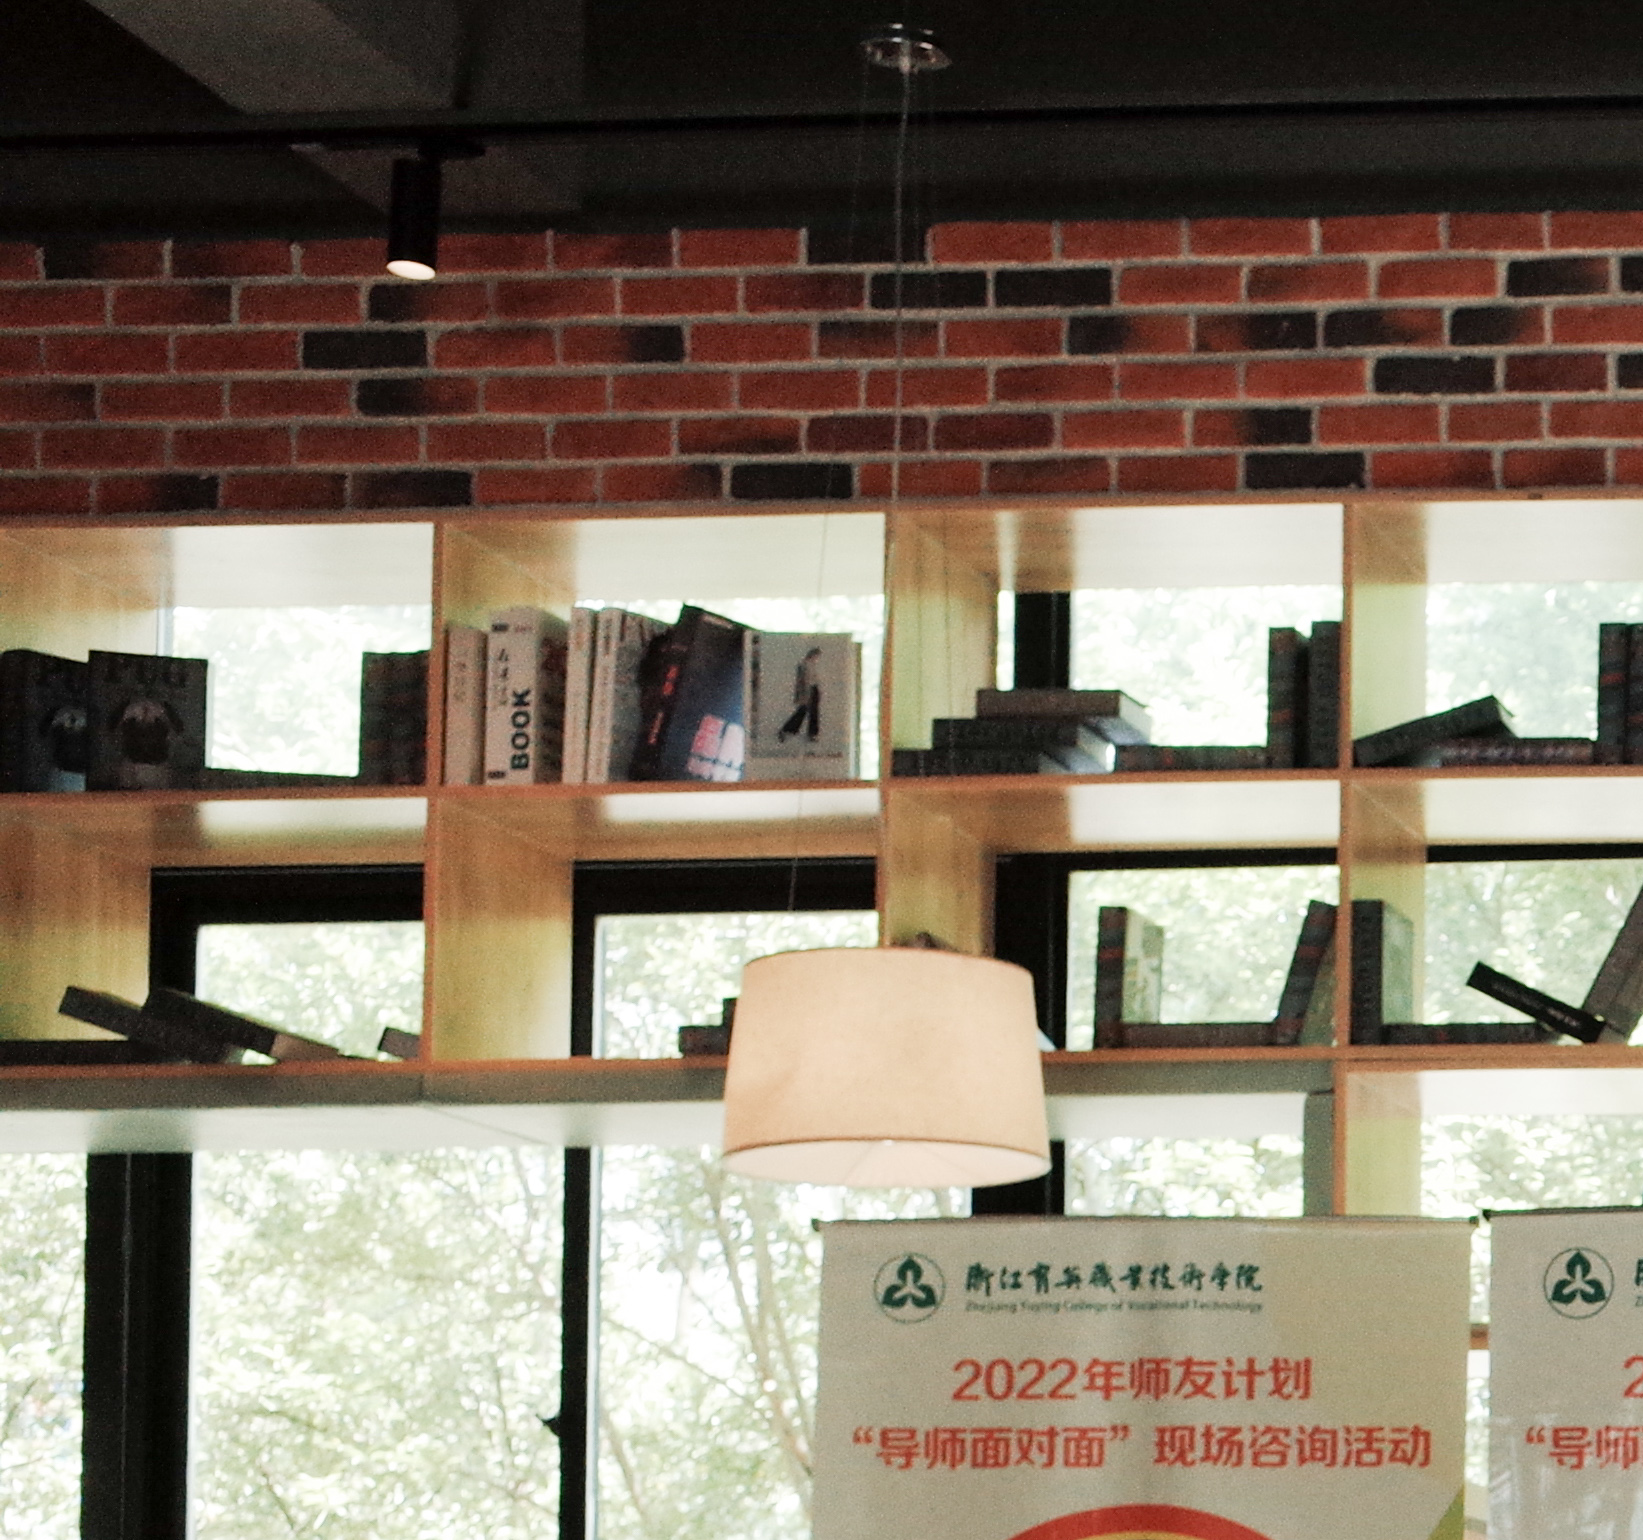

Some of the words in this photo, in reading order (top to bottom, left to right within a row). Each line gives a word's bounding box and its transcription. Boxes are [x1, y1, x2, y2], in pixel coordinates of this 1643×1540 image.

[511, 689, 531, 770] BOOK
[951, 1356, 1312, 1402] 2022年师友计划
